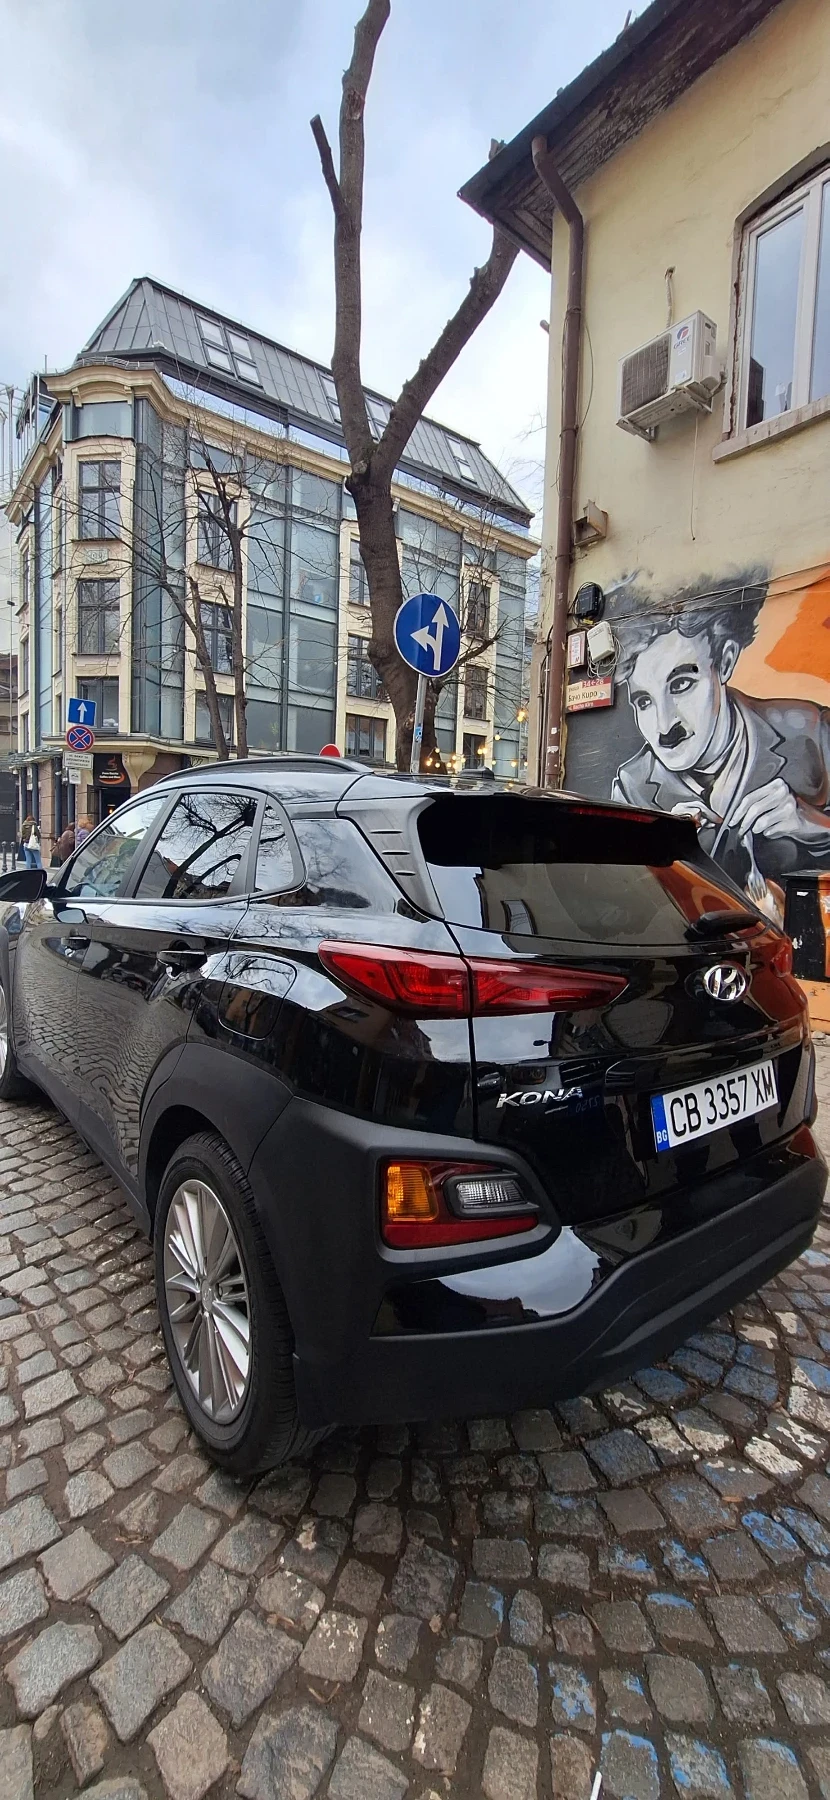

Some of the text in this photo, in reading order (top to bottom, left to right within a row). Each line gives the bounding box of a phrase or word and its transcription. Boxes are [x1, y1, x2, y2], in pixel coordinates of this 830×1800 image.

[495, 1086, 583, 1109] KONA
[670, 1065, 775, 1138] CB 3357 XM
[656, 1129, 668, 1144] BG
